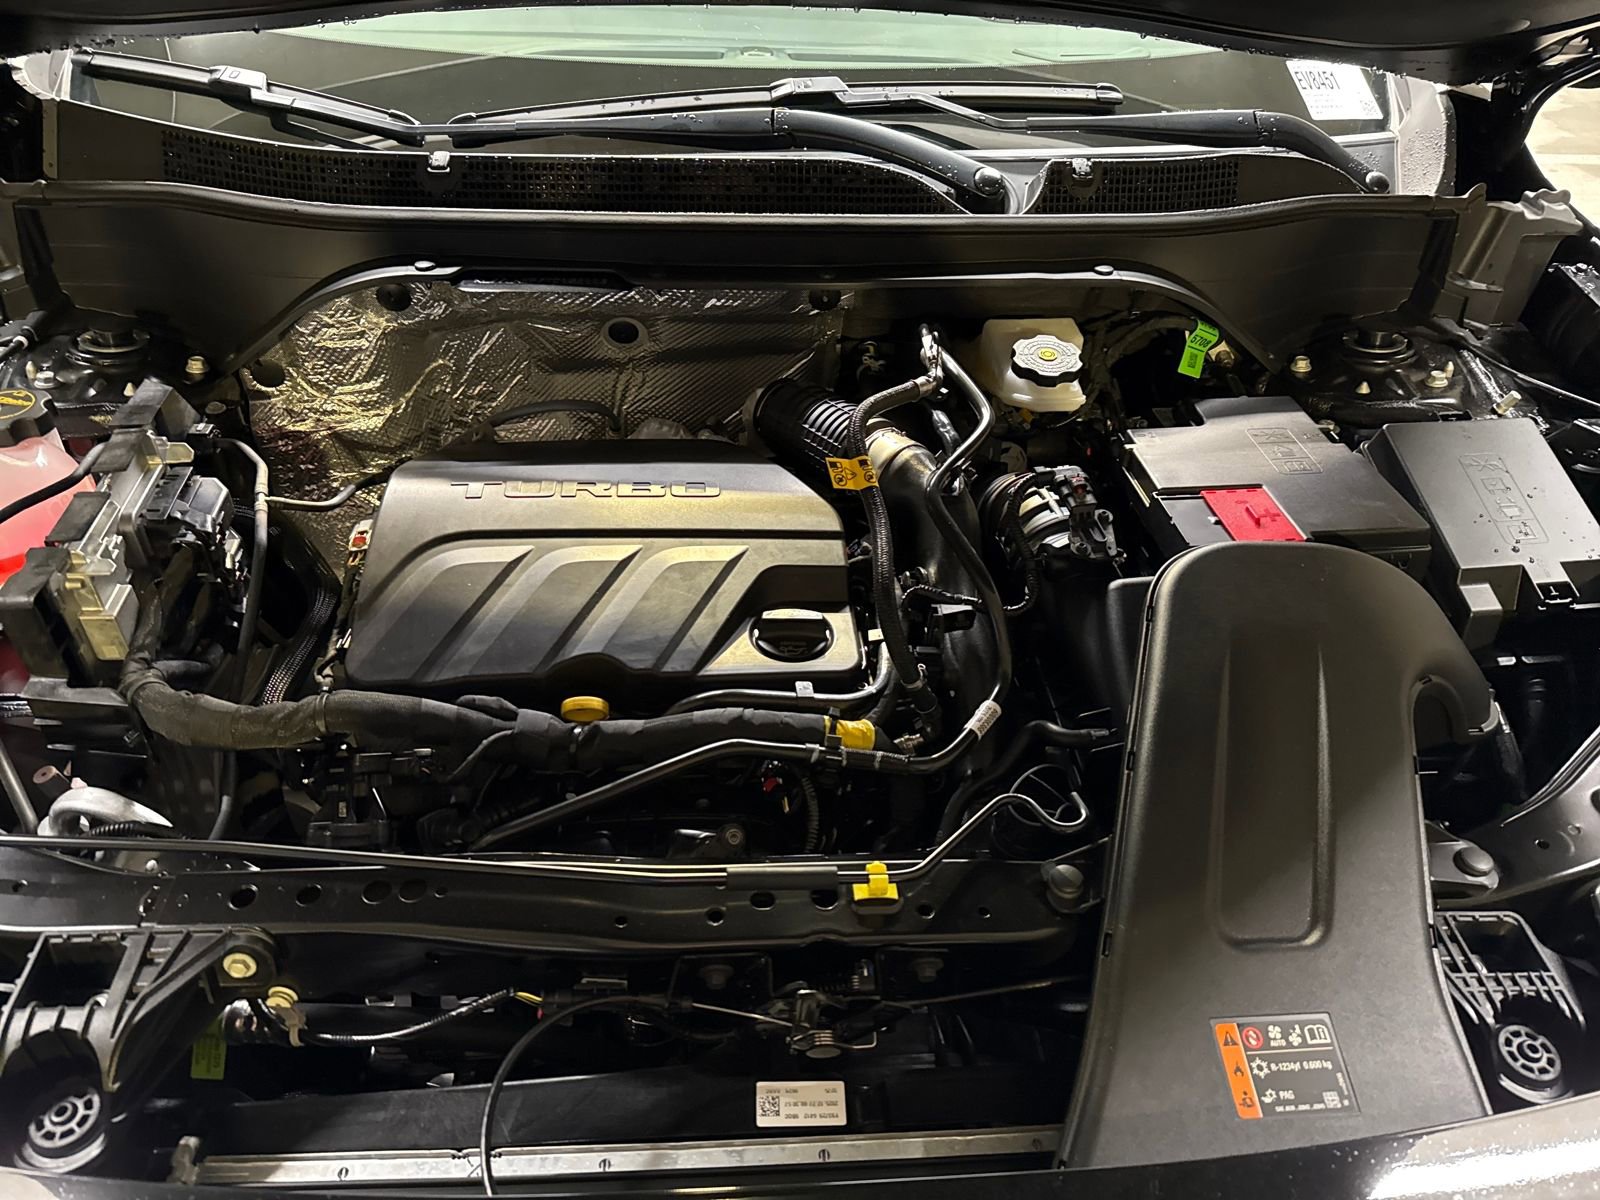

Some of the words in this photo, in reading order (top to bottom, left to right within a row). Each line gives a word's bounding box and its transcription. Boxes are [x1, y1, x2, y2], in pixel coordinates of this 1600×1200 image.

[1294, 71, 1341, 90] EV8451
[450, 480, 721, 499] TURBO
[1270, 1039, 1287, 1047] AUTO
[1322, 1059, 1333, 1071] kg
[1279, 1090, 1296, 1100] PAG
